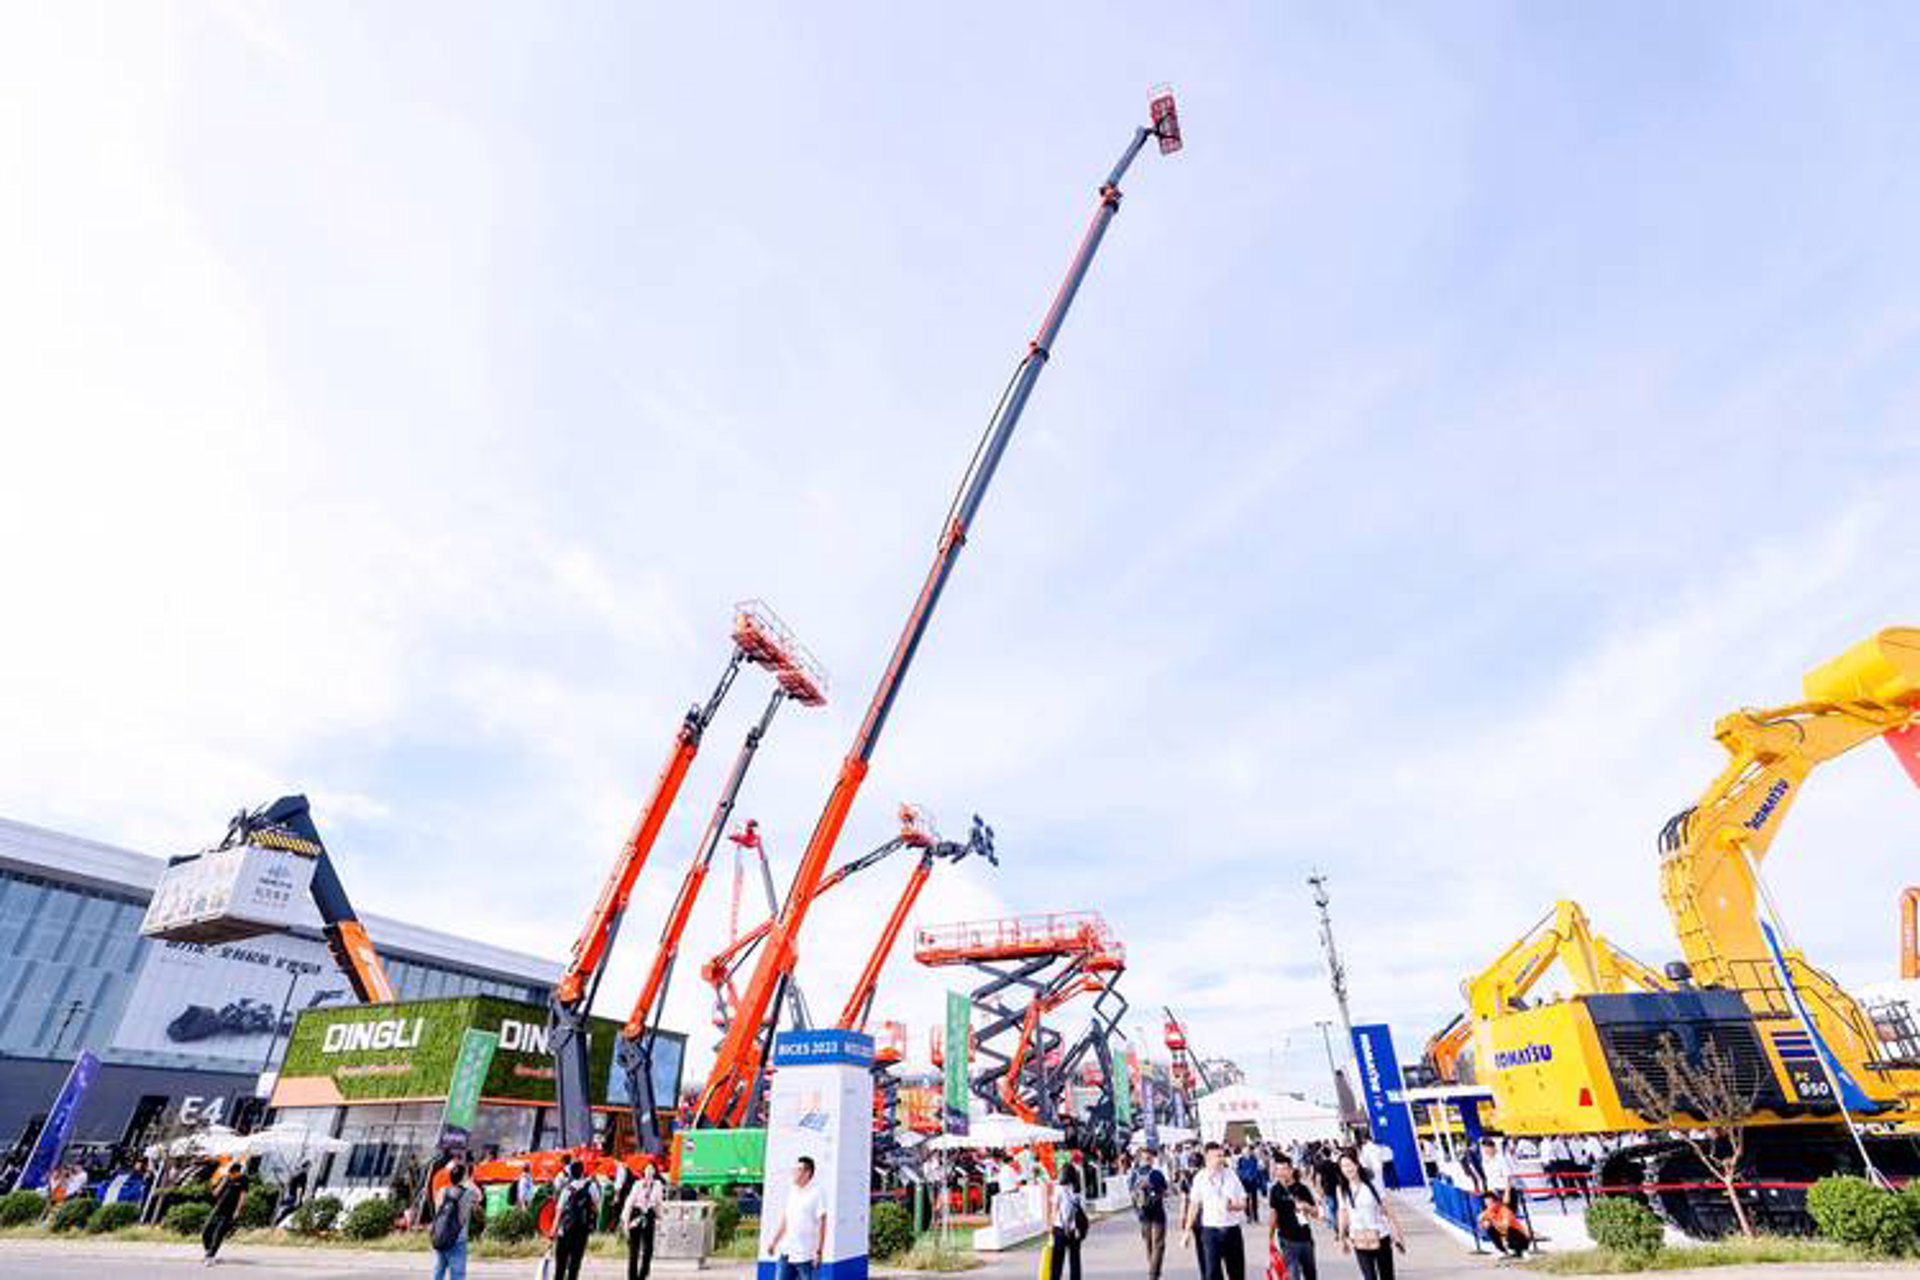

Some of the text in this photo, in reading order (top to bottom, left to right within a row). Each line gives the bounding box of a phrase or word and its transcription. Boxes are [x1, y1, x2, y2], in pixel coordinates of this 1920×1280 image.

[1743, 778, 1789, 831] KOMATSU
[322, 1017, 425, 1053] DINGLI
[778, 1043, 810, 1057] BICES
[811, 1041, 839, 1055] 2023
[1494, 1043, 1552, 1070] KOMATSU
[180, 1096, 225, 1126] E4
